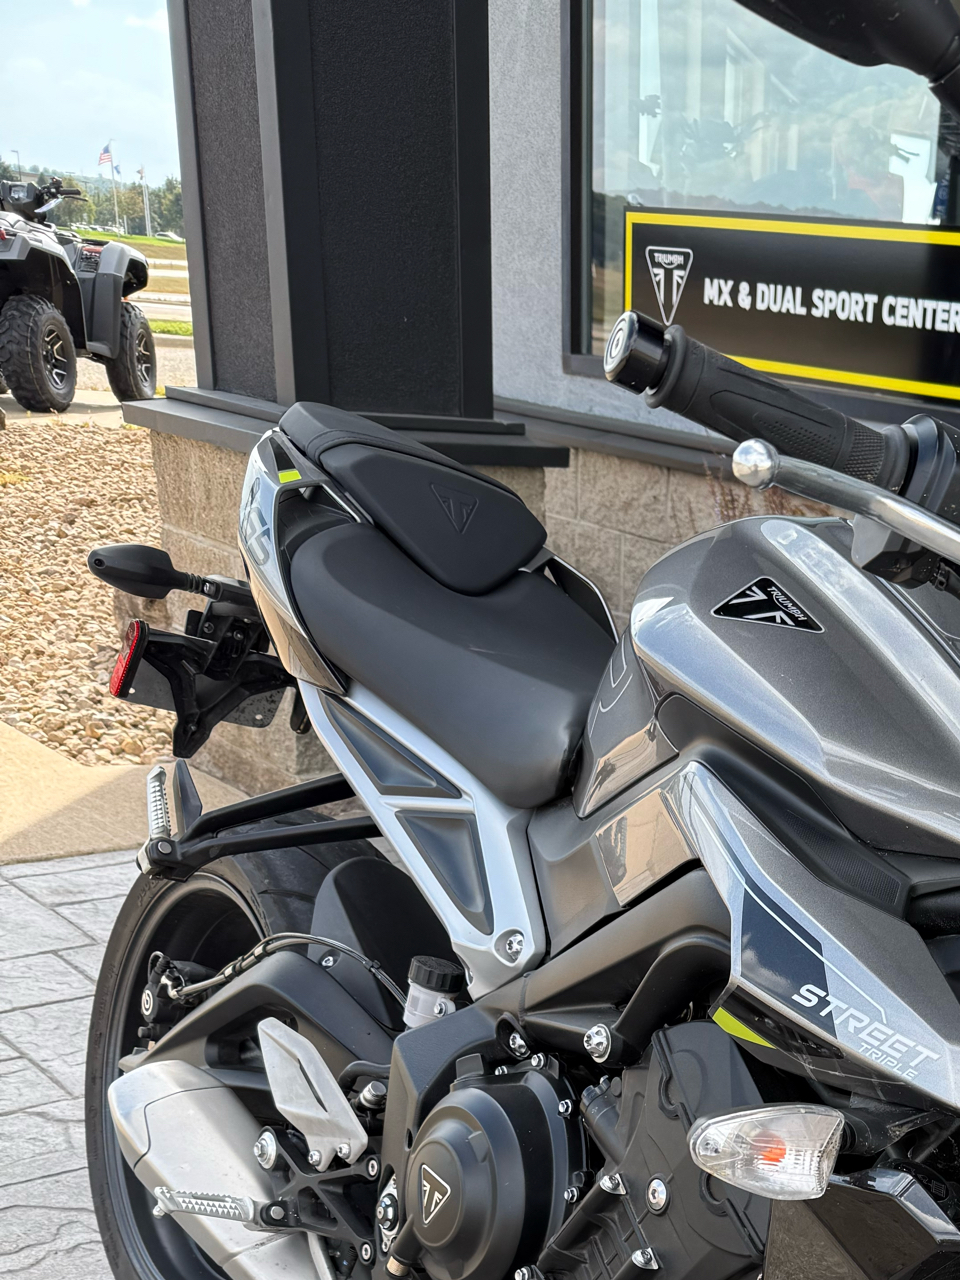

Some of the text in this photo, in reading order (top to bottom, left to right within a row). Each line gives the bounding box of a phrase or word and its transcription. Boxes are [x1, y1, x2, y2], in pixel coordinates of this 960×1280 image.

[653, 253, 684, 267] TRIUMPH
[703, 277, 734, 307] MX
[737, 281, 752, 311] &
[755, 282, 807, 316] DUAL
[811, 288, 878, 323] SPORT
[767, 586, 807, 620] TRIUMPH
[791, 983, 942, 1067] STREET
[859, 1042, 919, 1080] TRIPLE
